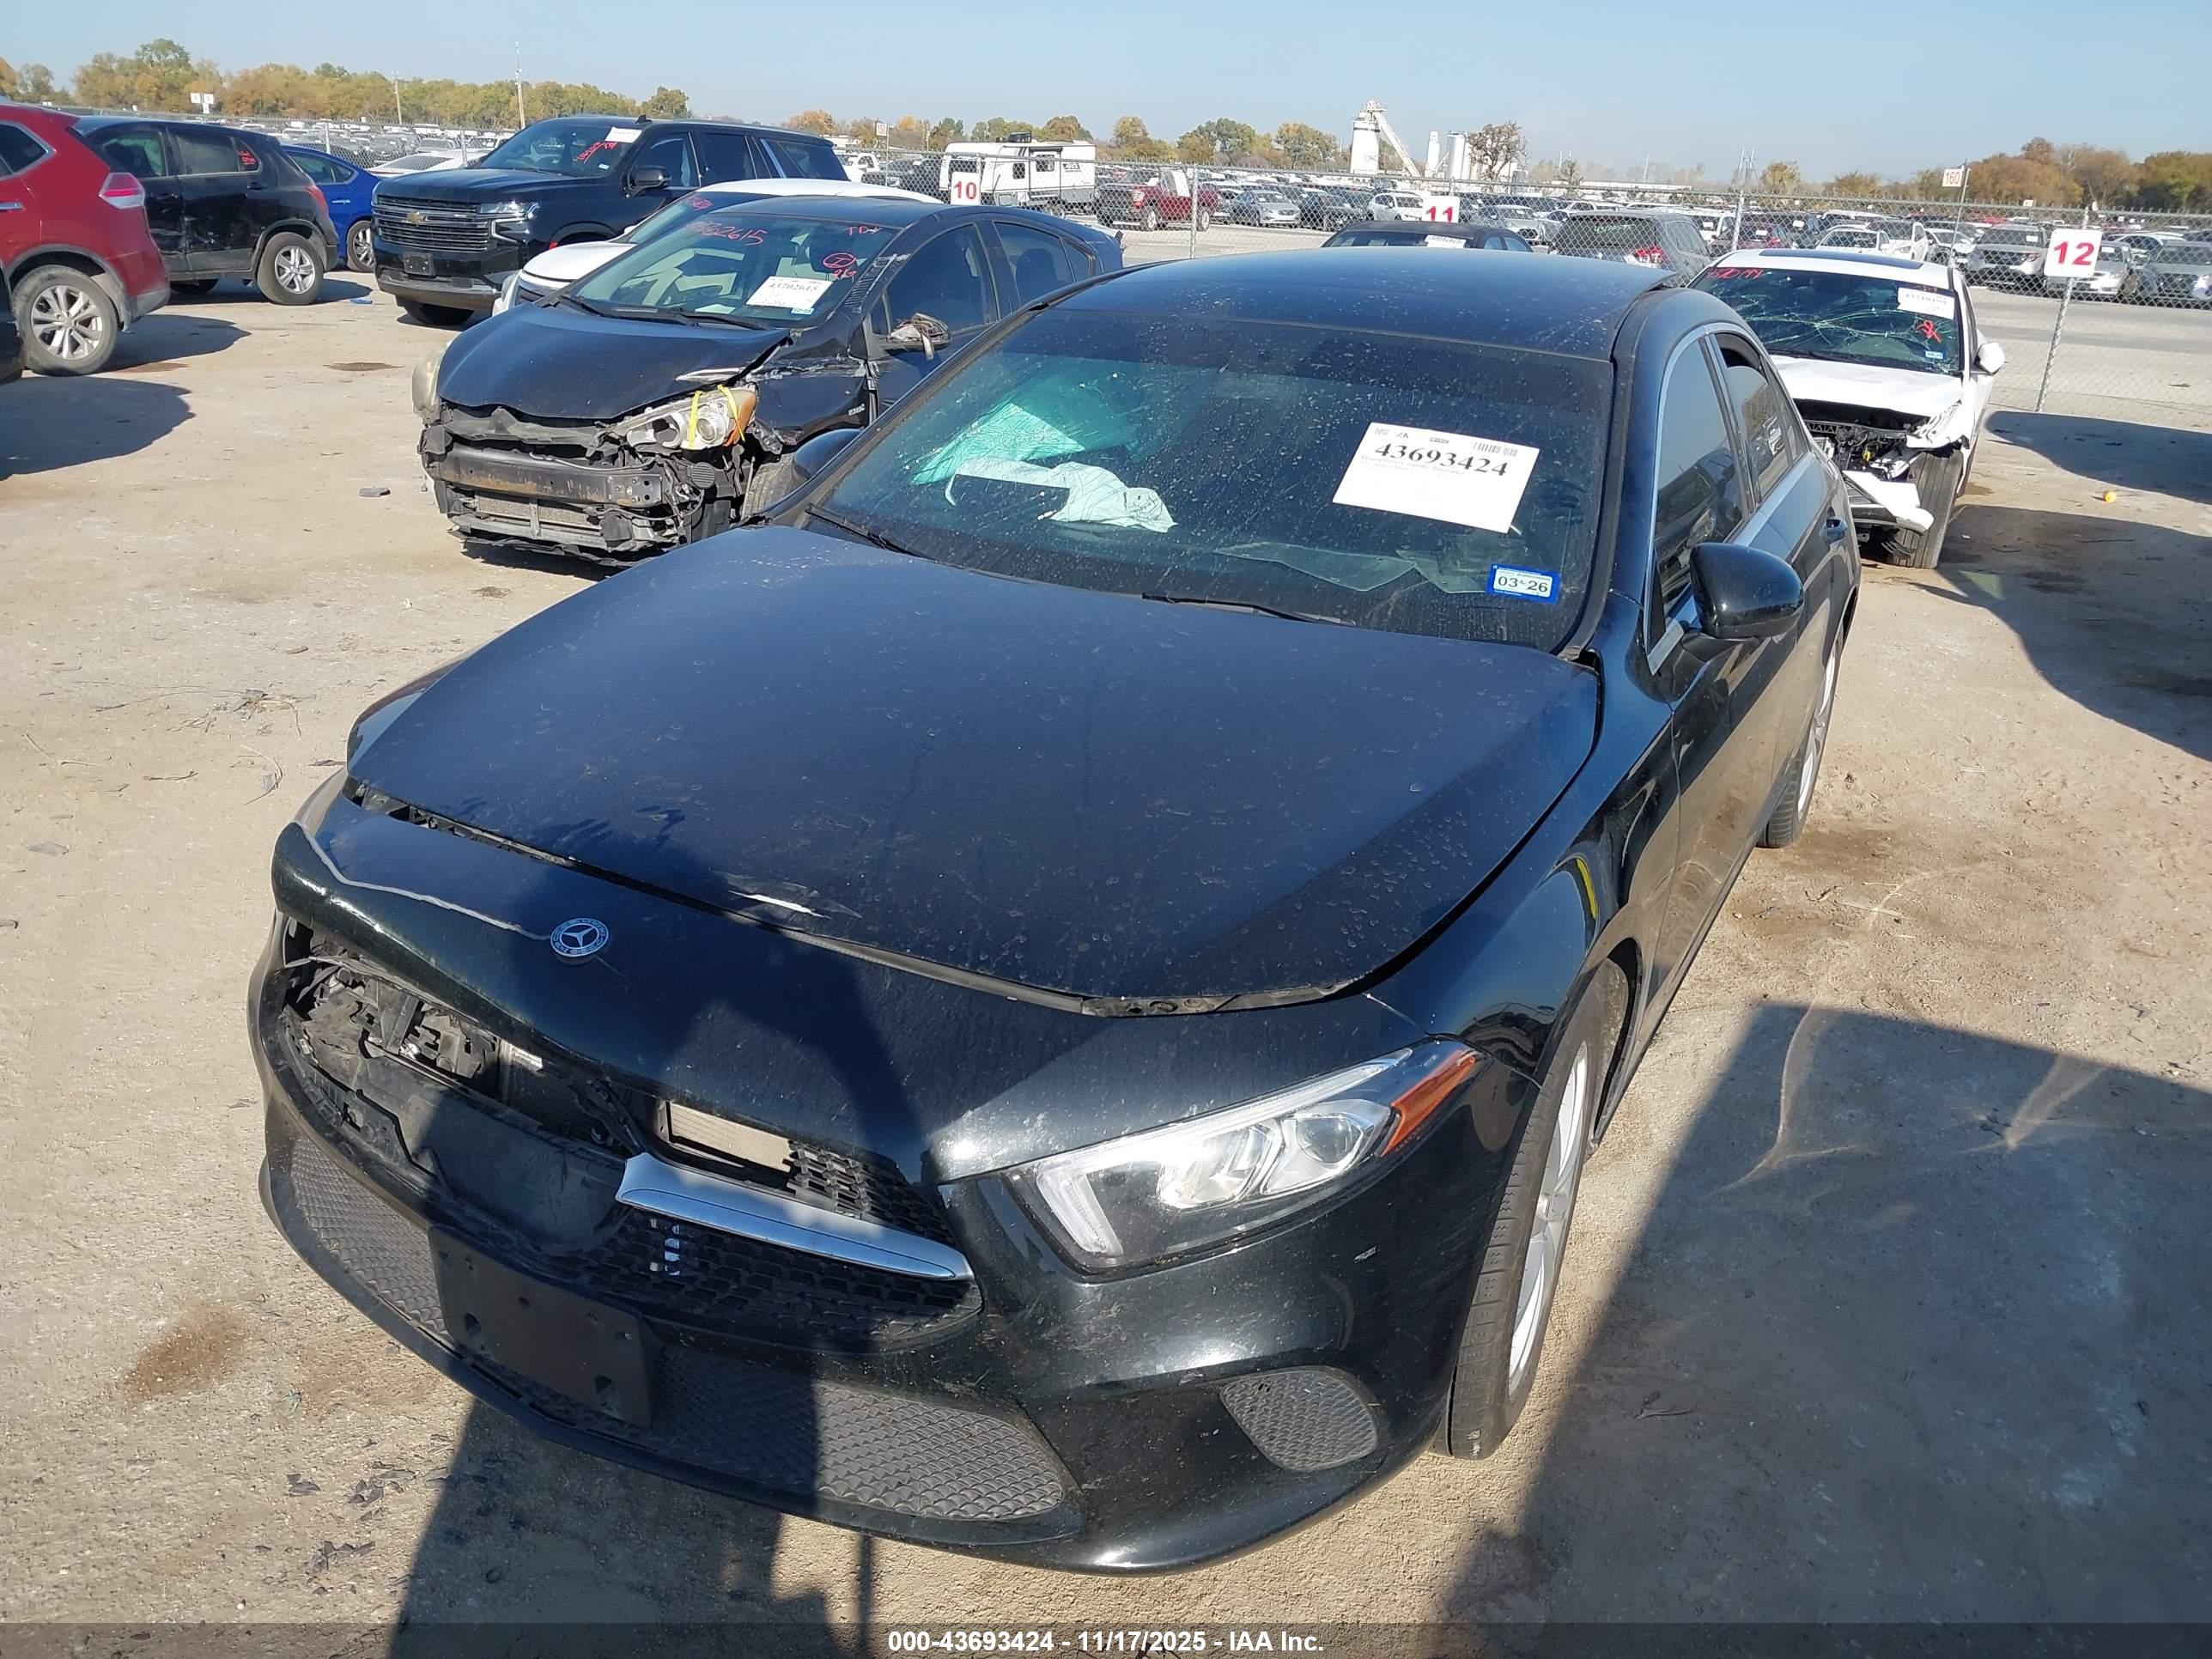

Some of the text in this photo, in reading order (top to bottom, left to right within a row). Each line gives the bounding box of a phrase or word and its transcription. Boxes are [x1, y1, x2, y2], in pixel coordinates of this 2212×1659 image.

[1945, 171, 1960, 185] 160
[953, 180, 977, 200] 10
[1425, 205, 1454, 222] 11
[2053, 240, 2094, 266] 12
[1375, 442, 1508, 477] 43693424
[1498, 575, 1518, 588] 03
[1527, 580, 1549, 592] 26
